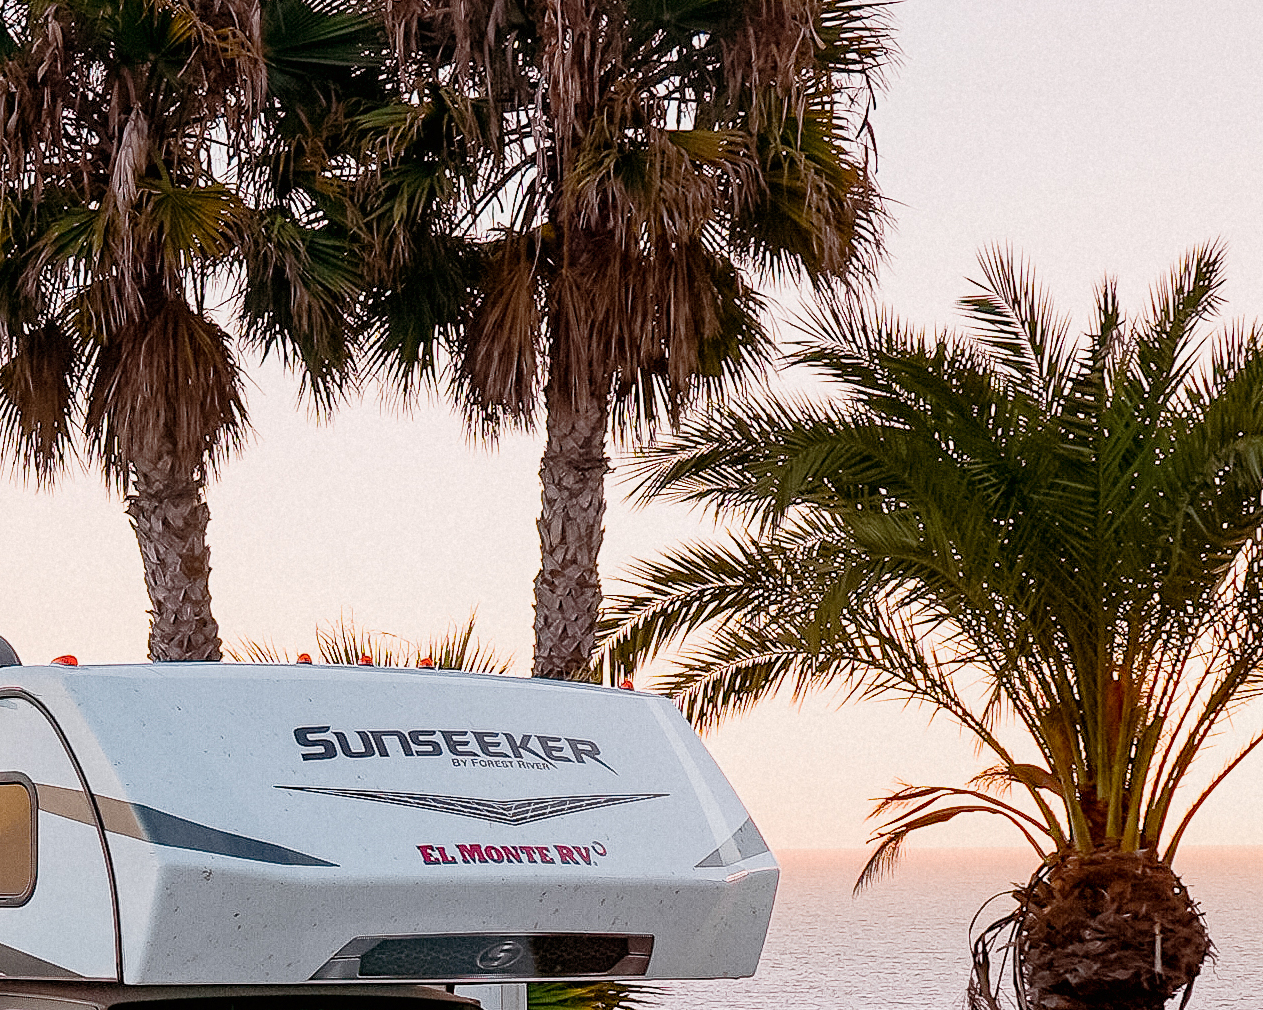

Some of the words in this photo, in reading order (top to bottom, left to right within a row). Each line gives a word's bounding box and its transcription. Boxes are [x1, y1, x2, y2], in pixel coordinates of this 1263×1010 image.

[293, 725, 619, 776] SUNSEEKER
[452, 758, 468, 768] BY
[471, 759, 515, 769] FOREST
[518, 760, 551, 771] RIVER
[416, 844, 459, 866] EL
[455, 843, 557, 866] MONTE
